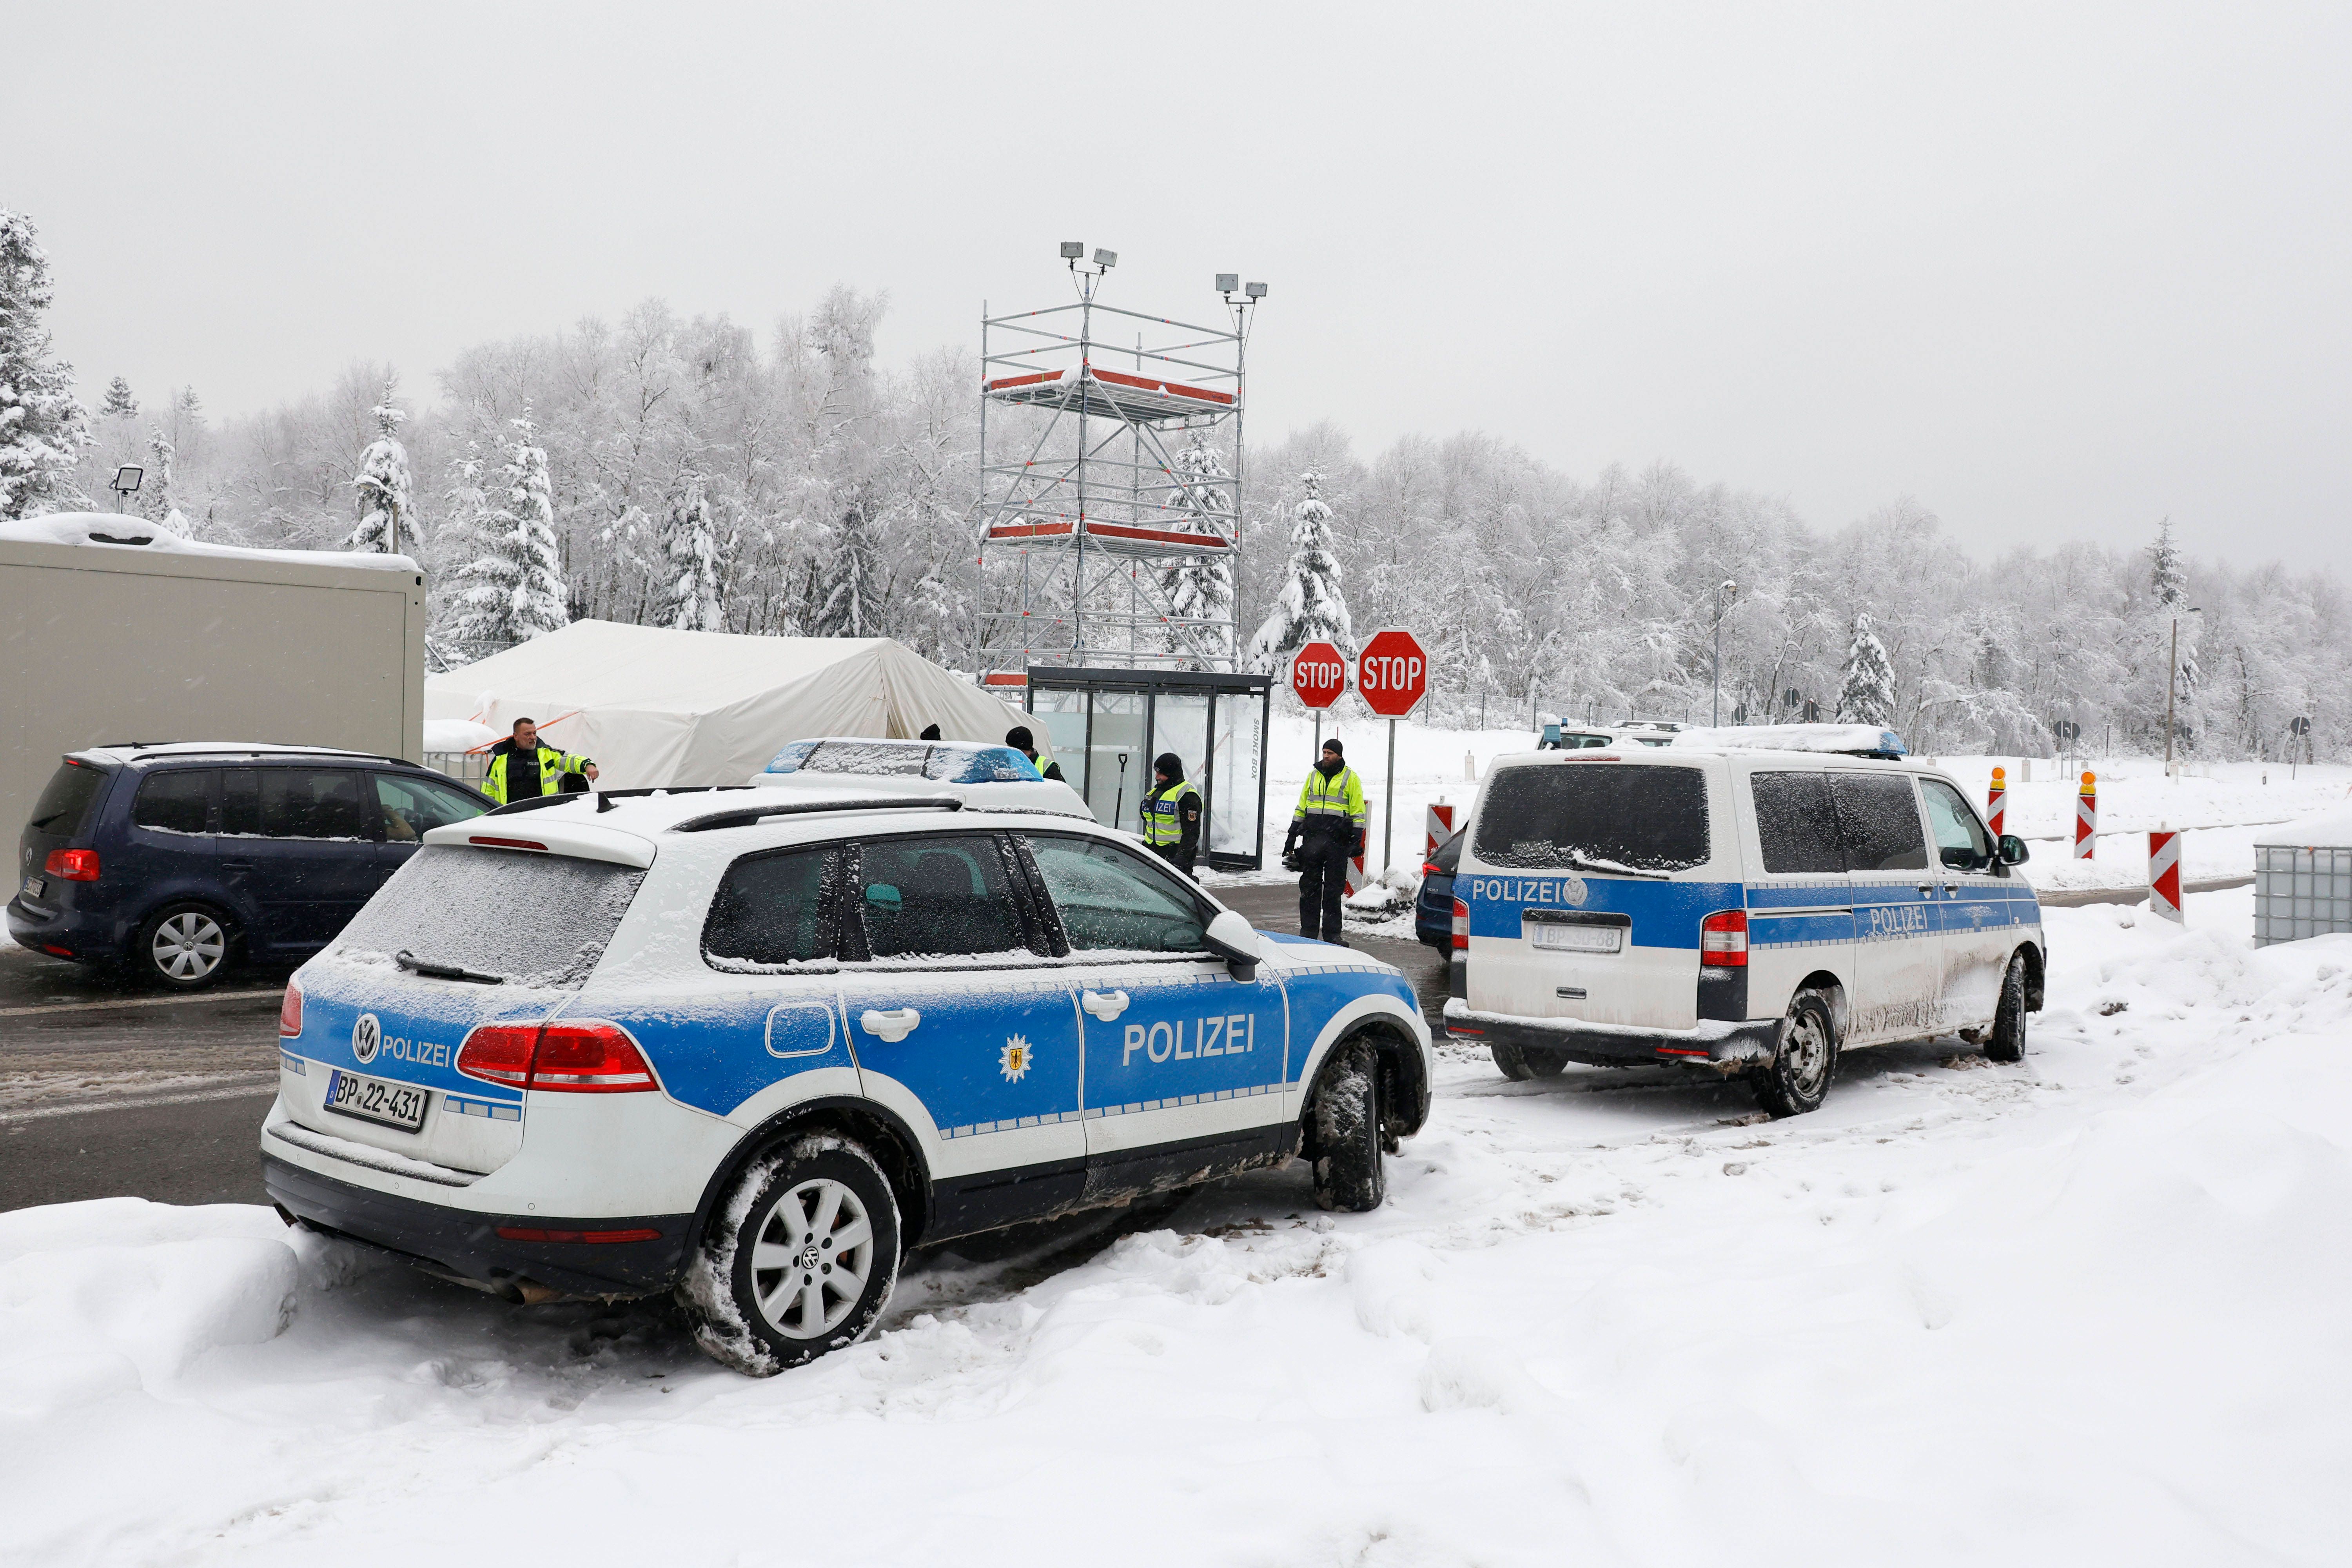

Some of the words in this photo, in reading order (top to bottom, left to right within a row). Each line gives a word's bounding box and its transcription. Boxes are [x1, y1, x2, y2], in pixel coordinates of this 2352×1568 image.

[1297, 661, 1341, 689] STOP
[1364, 656, 1421, 690] STOP
[1473, 880, 1561, 903] POLIZEI
[1870, 906, 1928, 933] POLIZEI
[1547, 928, 1565, 944] BP
[382, 1035, 450, 1067] POLIZEI
[1123, 1014, 1254, 1067] POLIZEI
[336, 1076, 358, 1104] BP
[362, 1083, 420, 1122] 22-431
